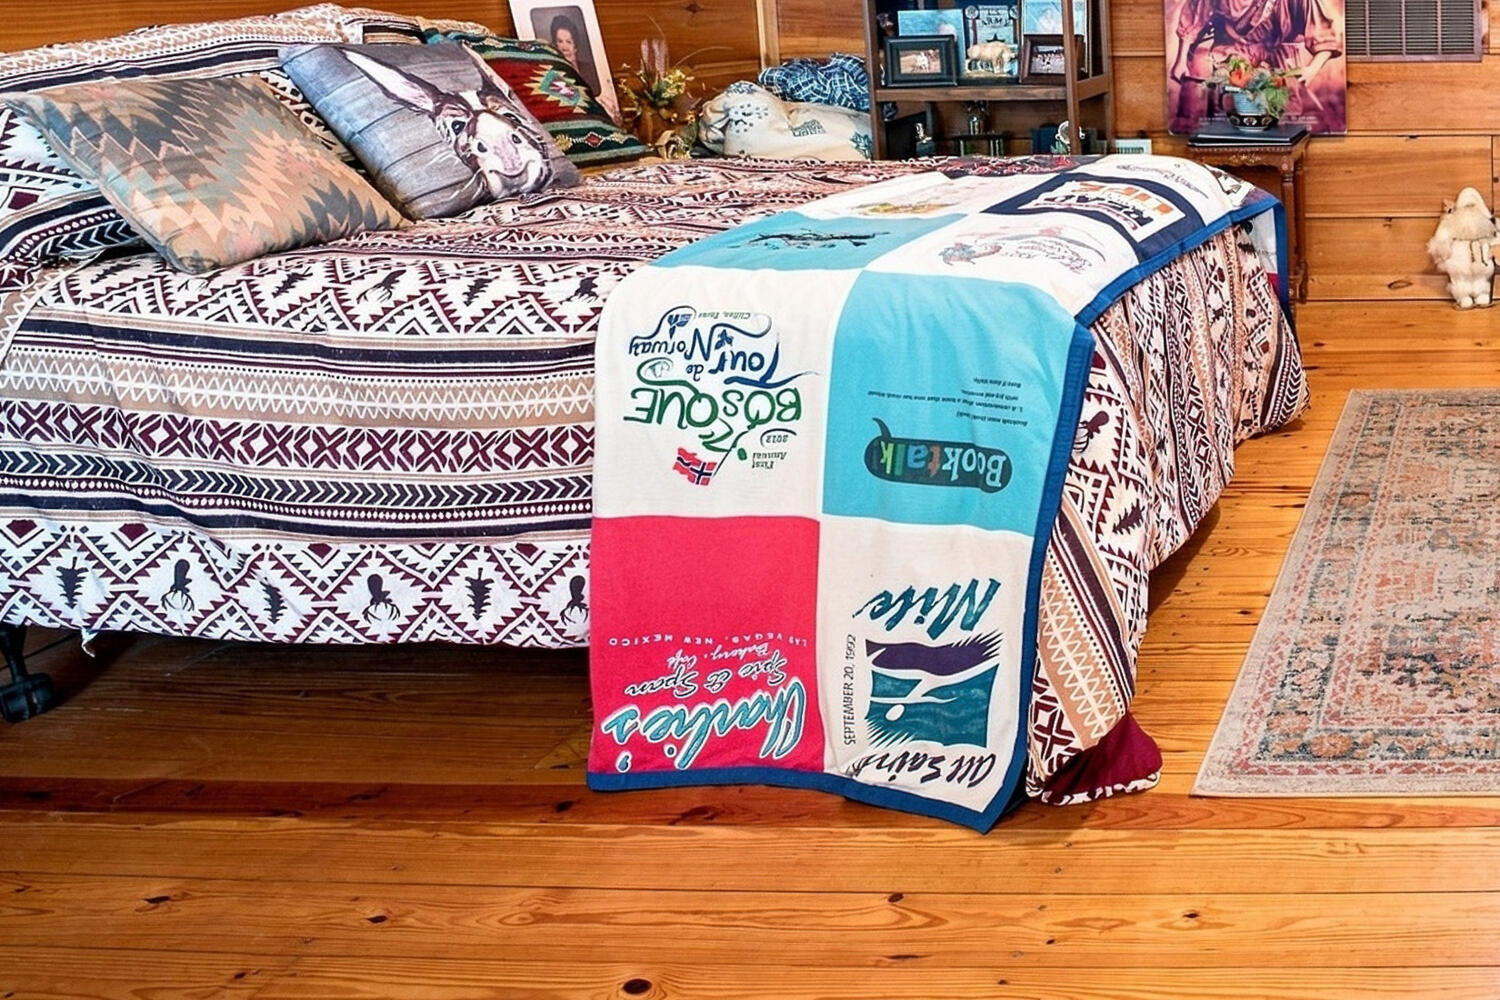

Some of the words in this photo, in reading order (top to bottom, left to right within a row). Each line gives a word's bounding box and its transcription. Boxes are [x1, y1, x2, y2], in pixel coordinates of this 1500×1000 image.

[629, 327, 714, 362] Norway
[686, 364, 704, 381] de
[709, 340, 806, 390] Tour
[623, 384, 802, 430] BOSQUE
[879, 441, 1007, 488] Booktalk
[852, 578, 1001, 641] Mile
[608, 632, 673, 647] MEXICO
[683, 635, 714, 645] NEW
[788, 635, 808, 647] LAS
[844, 633, 858, 660] 1992
[624, 664, 699, 698] Span
[706, 668, 733, 691] &
[738, 652, 788, 686] Spic
[601, 677, 806, 773] Charlie's
[843, 681, 857, 745] SEPTEMBER
